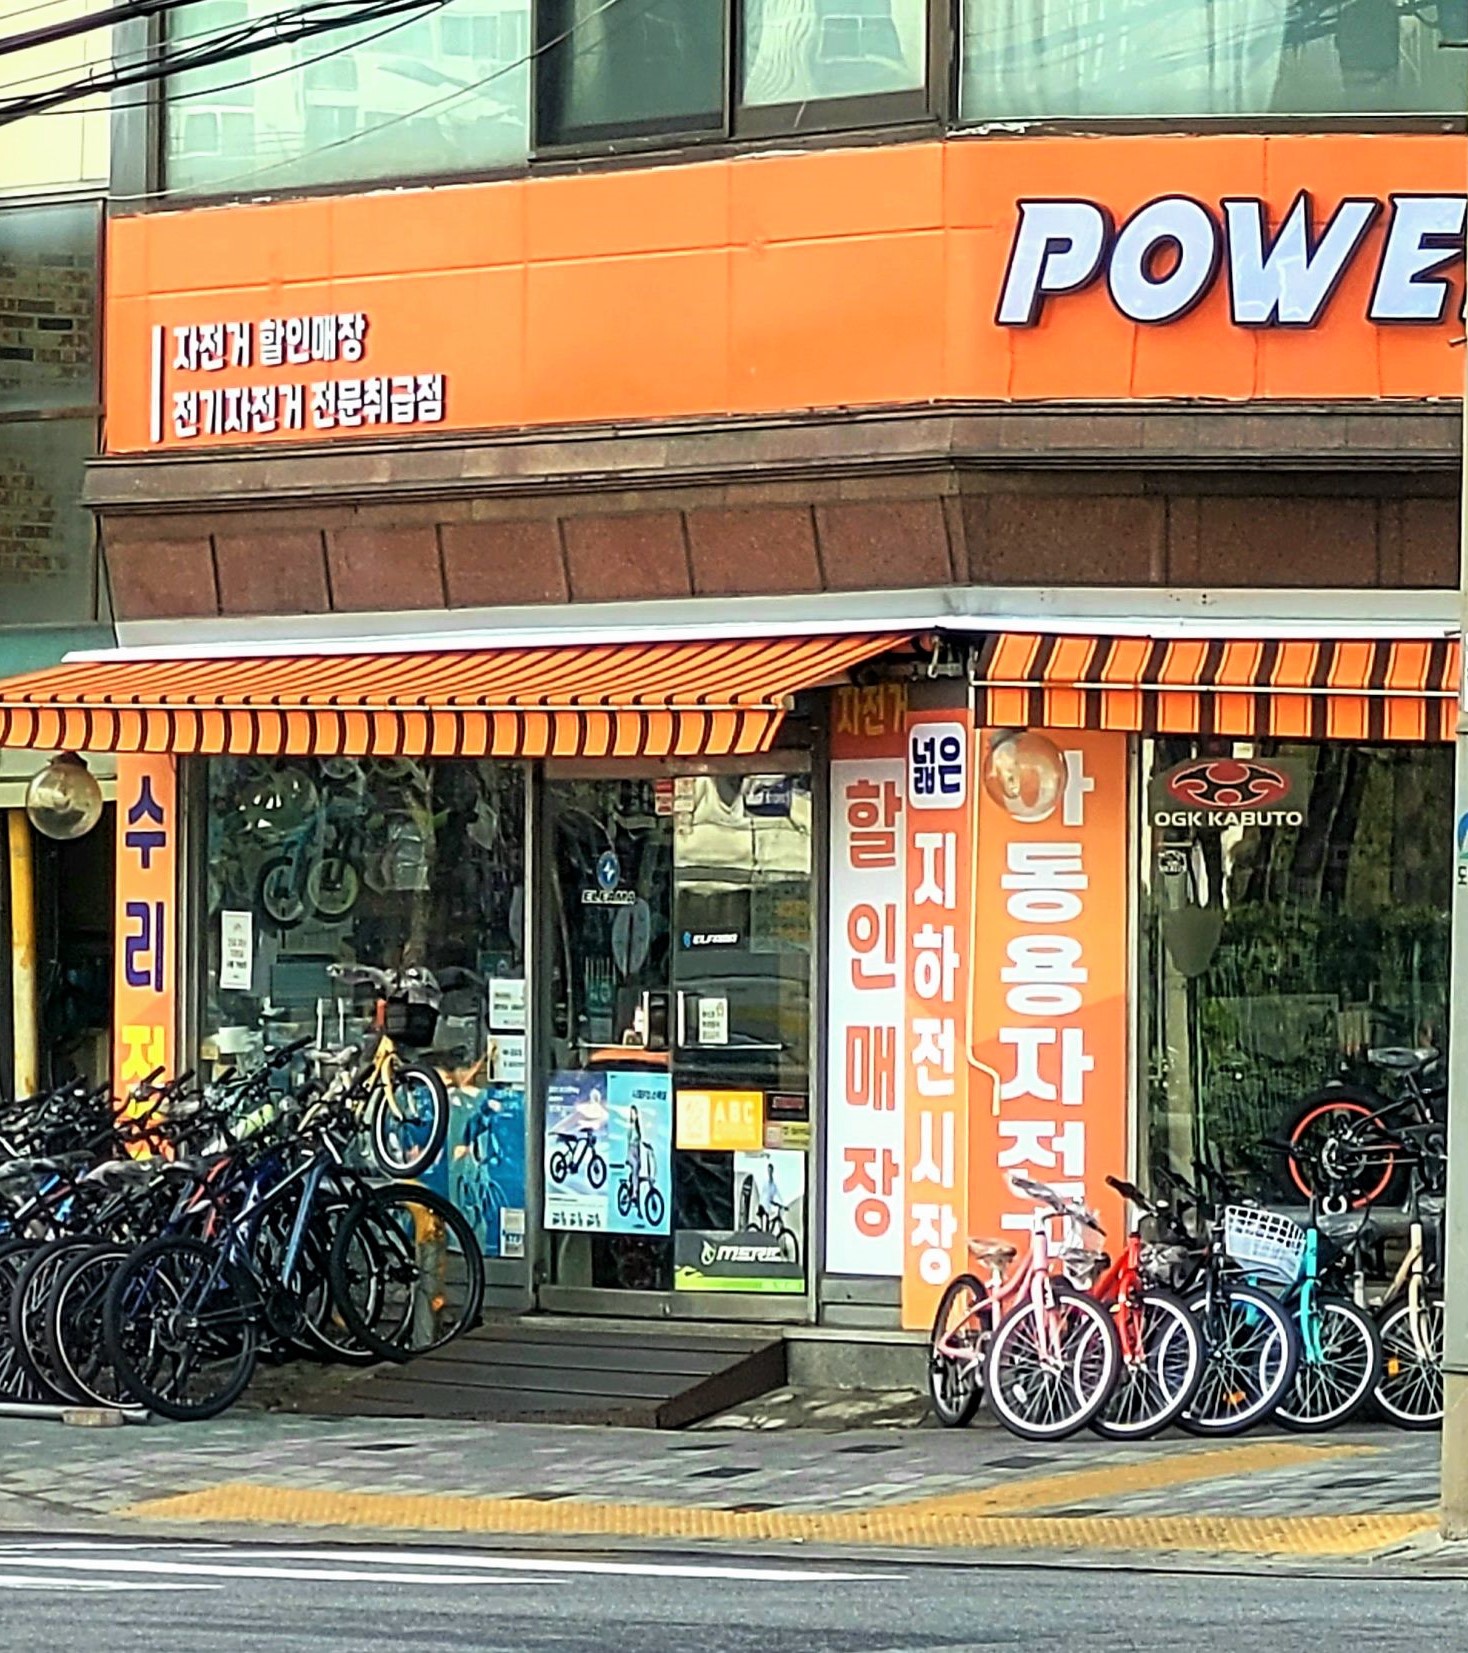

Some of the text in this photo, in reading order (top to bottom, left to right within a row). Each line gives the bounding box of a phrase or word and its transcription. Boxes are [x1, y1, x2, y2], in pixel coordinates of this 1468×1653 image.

[172, 312, 368, 372] 자전거 할인매장
[172, 374, 446, 438] 전기자전거 전문취급점
[911, 736, 962, 795] 넓은
[1154, 811, 1304, 827] OGK KABUTO
[842, 779, 902, 1238] 할인매장
